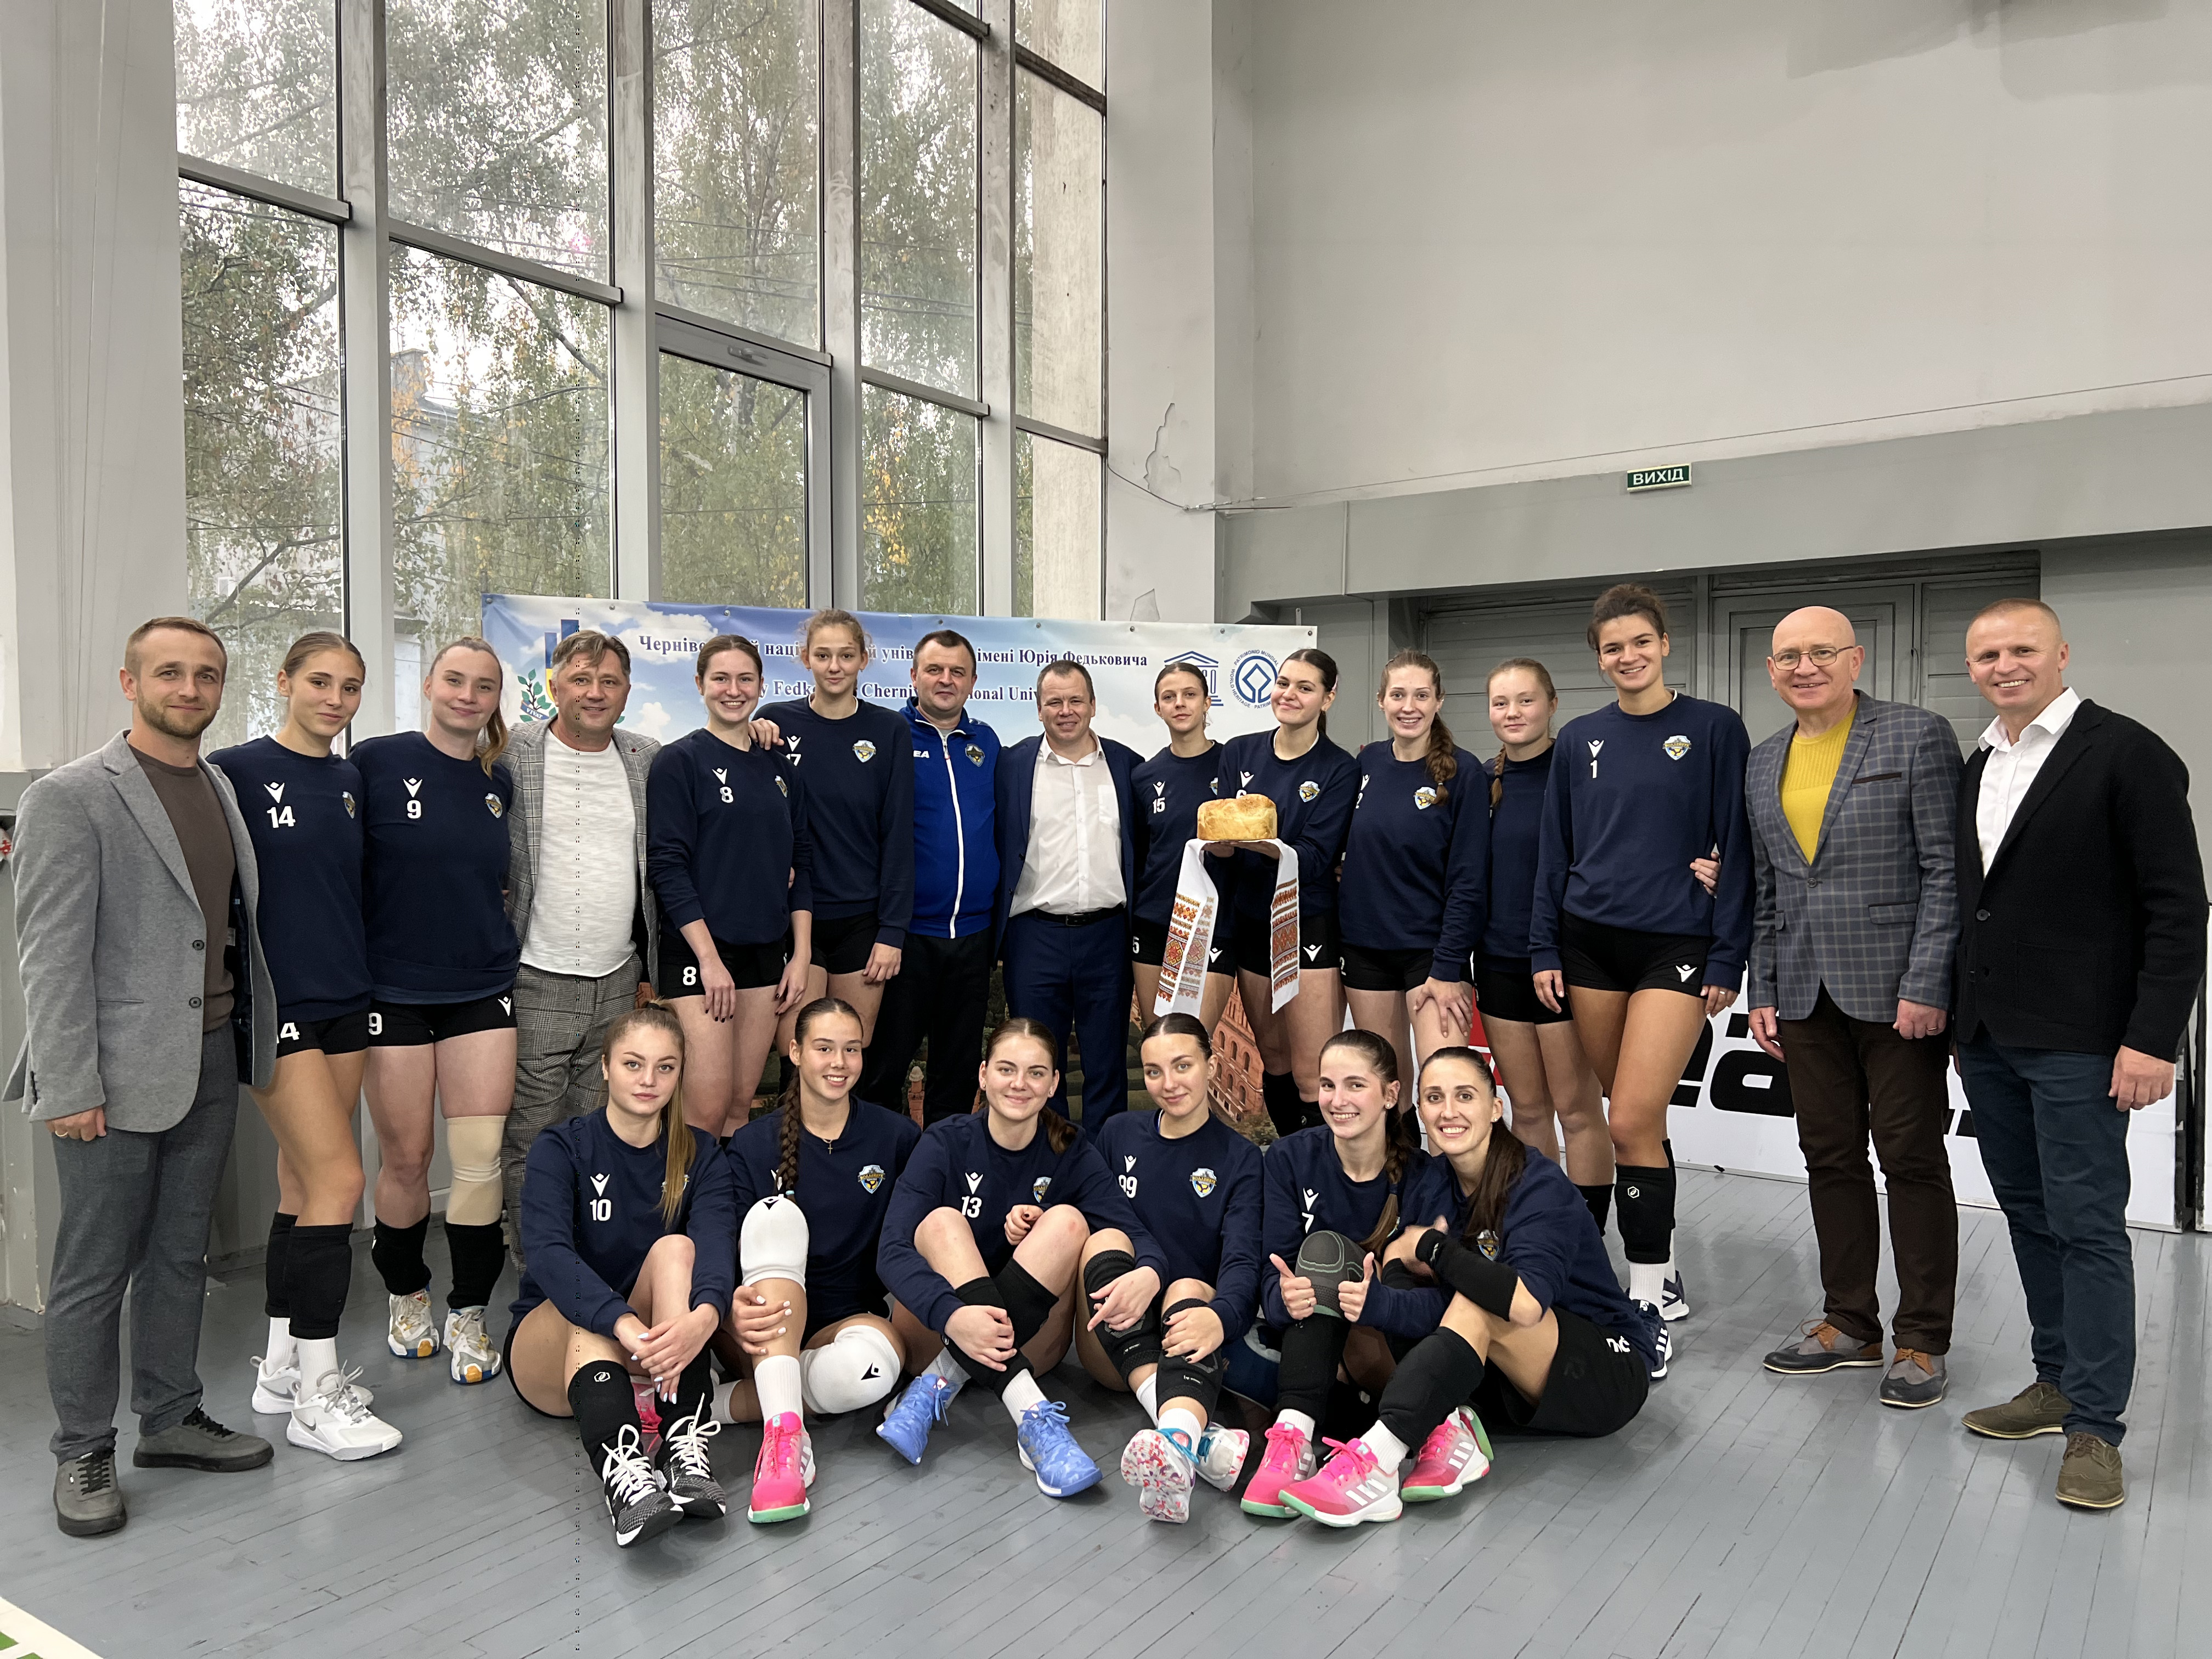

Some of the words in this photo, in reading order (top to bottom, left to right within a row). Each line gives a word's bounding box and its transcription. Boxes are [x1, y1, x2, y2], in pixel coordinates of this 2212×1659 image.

[1633, 468, 1684, 485] ВИХІД
[977, 648, 1014, 662] імені
[1019, 650, 1058, 667] Юрія
[1063, 651, 1147, 666] Федьковича
[1234, 650, 1260, 665] PATRIMONIO
[1261, 650, 1279, 667] MUNDIAL
[862, 684, 918, 698] Cherni
[1232, 689, 1251, 708] HERITAGE
[527, 708, 543, 719] VIVAT
[1589, 760, 1598, 778] 1
[719, 786, 734, 804] 8
[407, 800, 421, 819] 9
[1153, 797, 1165, 814] 15
[267, 805, 296, 828] 14
[682, 966, 697, 985] 8
[276, 1022, 300, 1043] 4
[368, 1012, 382, 1035] 9
[1118, 1174, 1138, 1199] 99
[590, 1199, 611, 1221] 10
[961, 1196, 982, 1218] 13
[1301, 1212, 1314, 1234] 7
